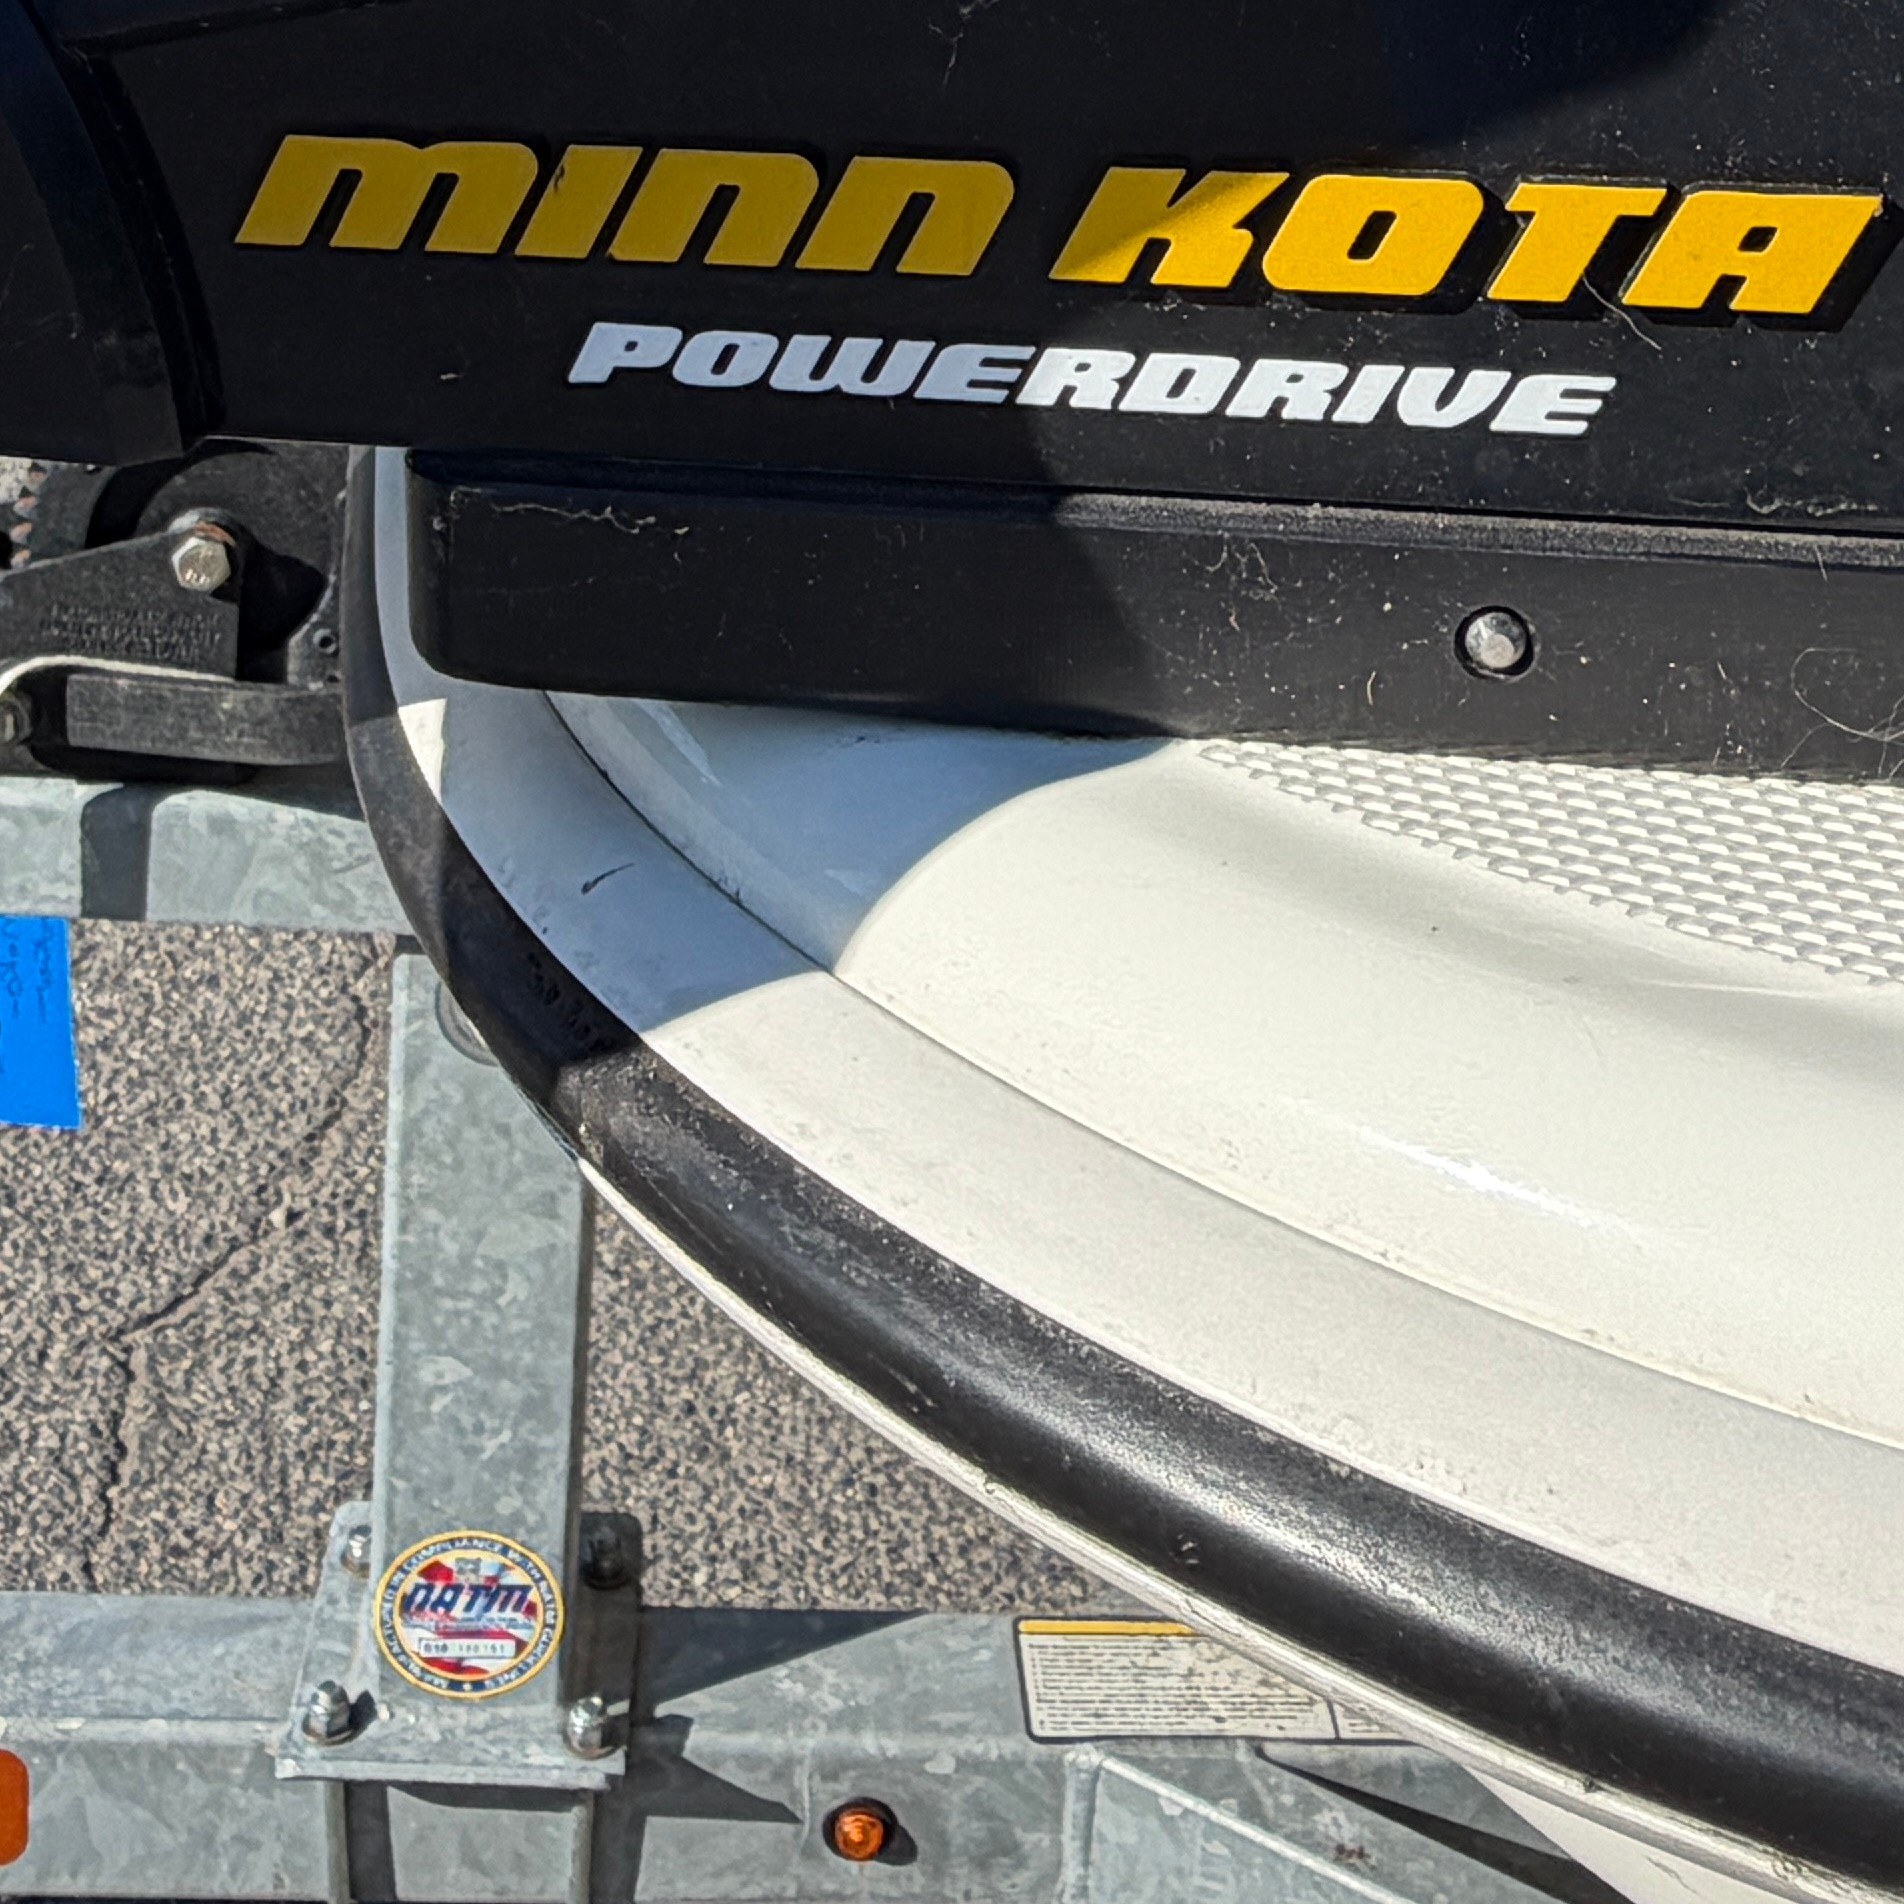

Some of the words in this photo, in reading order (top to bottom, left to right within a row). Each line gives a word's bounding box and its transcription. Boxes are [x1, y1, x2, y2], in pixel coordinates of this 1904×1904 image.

[235, 134, 1016, 276] MINN
[1050, 166, 1888, 315] KOTA
[568, 322, 1617, 436] POWERDRIVE
